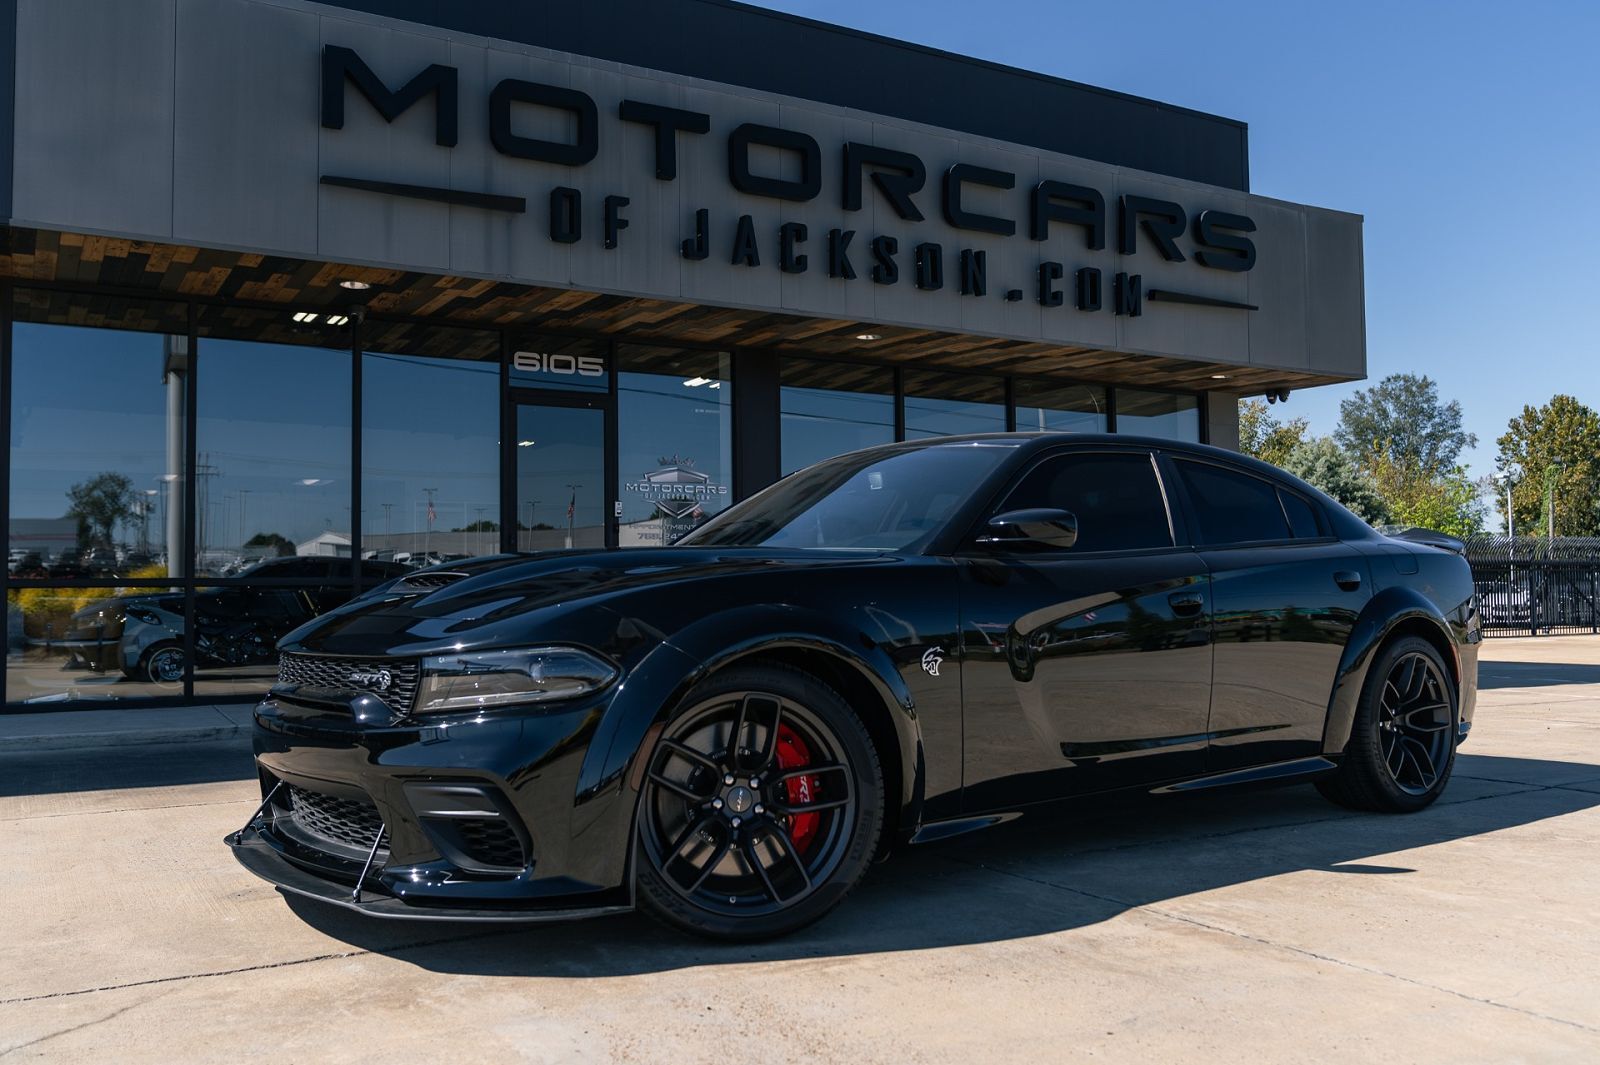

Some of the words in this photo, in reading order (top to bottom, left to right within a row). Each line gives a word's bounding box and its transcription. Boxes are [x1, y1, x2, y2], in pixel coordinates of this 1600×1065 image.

[322, 44, 1257, 272] MOTORCARS
[549, 186, 631, 249] OF
[513, 351, 604, 377] 6105
[625, 482, 728, 494] MOTORCARS
